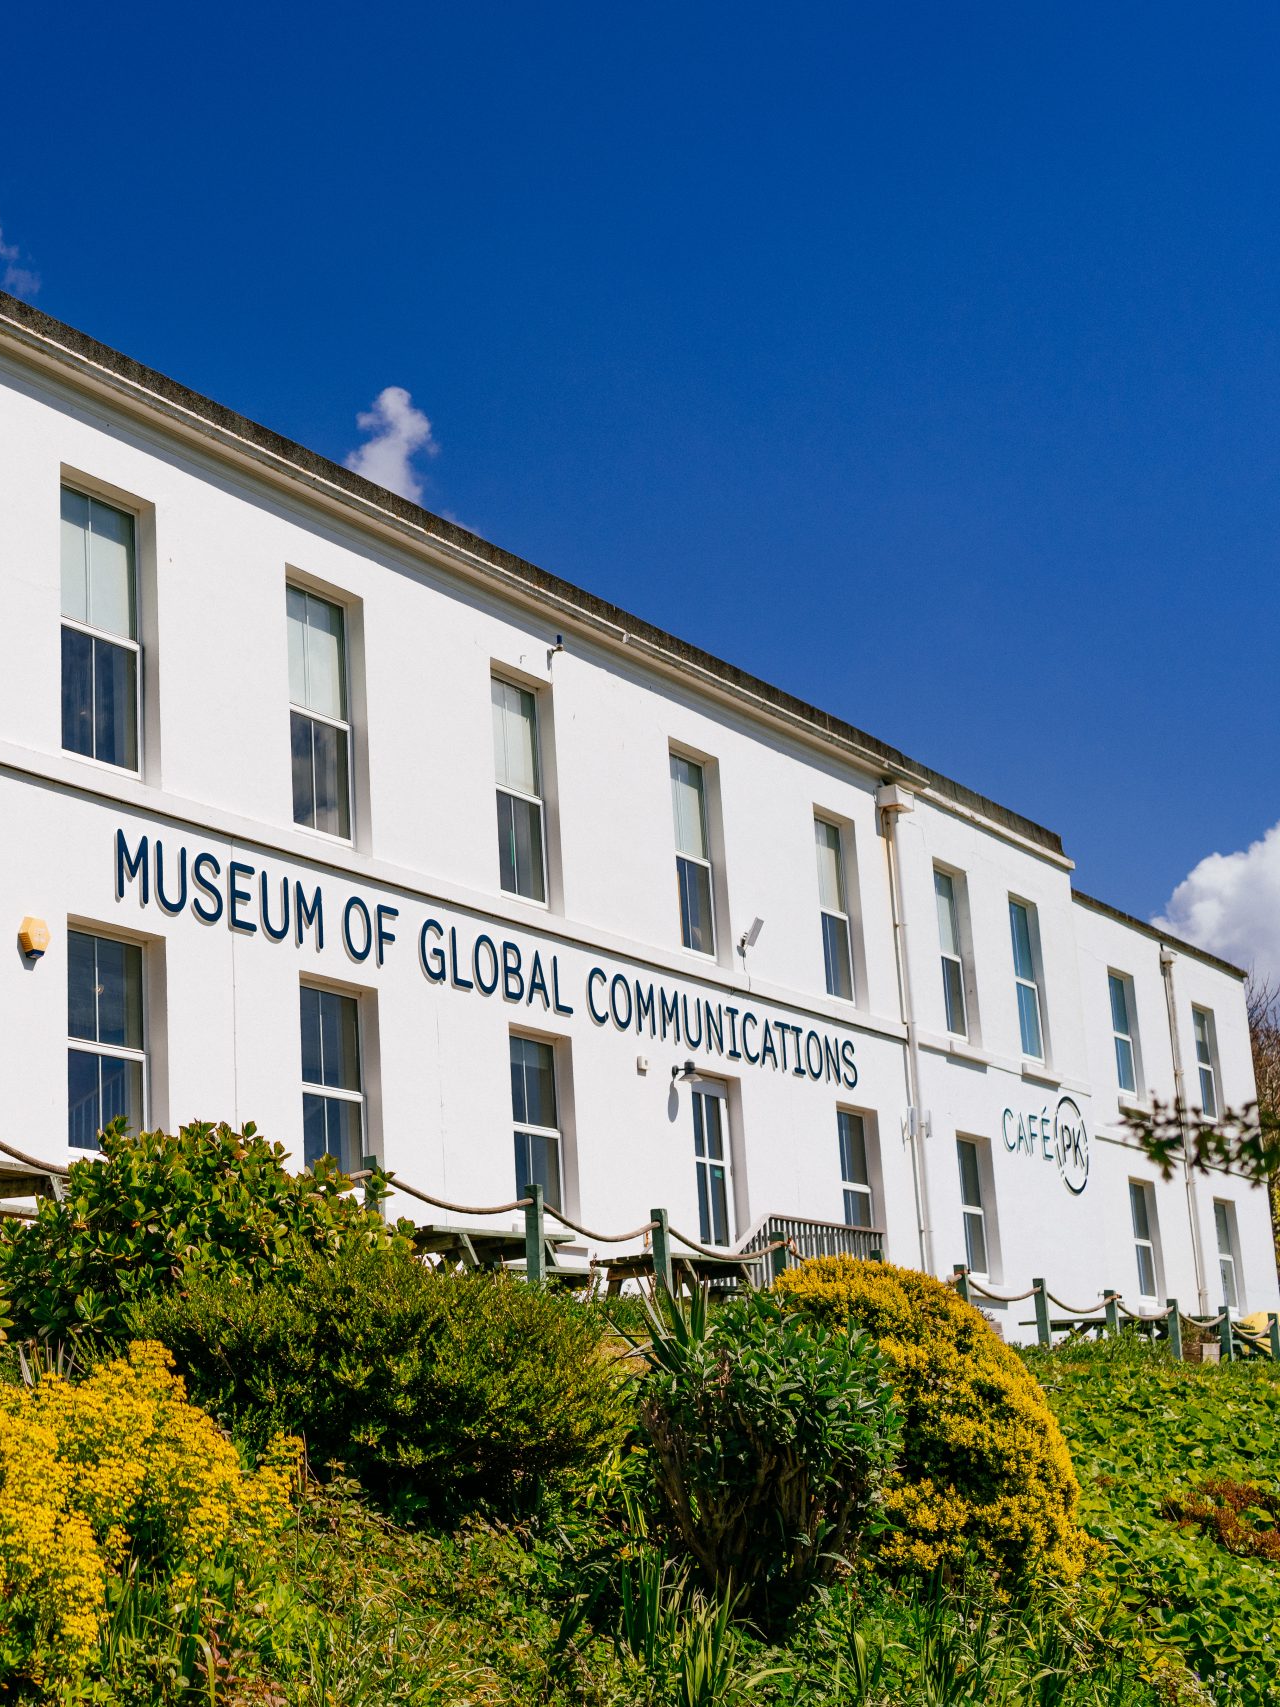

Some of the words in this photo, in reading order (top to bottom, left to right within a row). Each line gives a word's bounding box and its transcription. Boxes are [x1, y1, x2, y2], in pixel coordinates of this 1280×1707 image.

[116, 828, 323, 949] MUSEUM
[342, 895, 400, 966] OF
[419, 918, 574, 1015] GLOBAL
[586, 966, 858, 1089] COMMUNICATIONS
[1003, 1106, 1054, 1160] CAFÉ
[1061, 1124, 1085, 1168] PK
